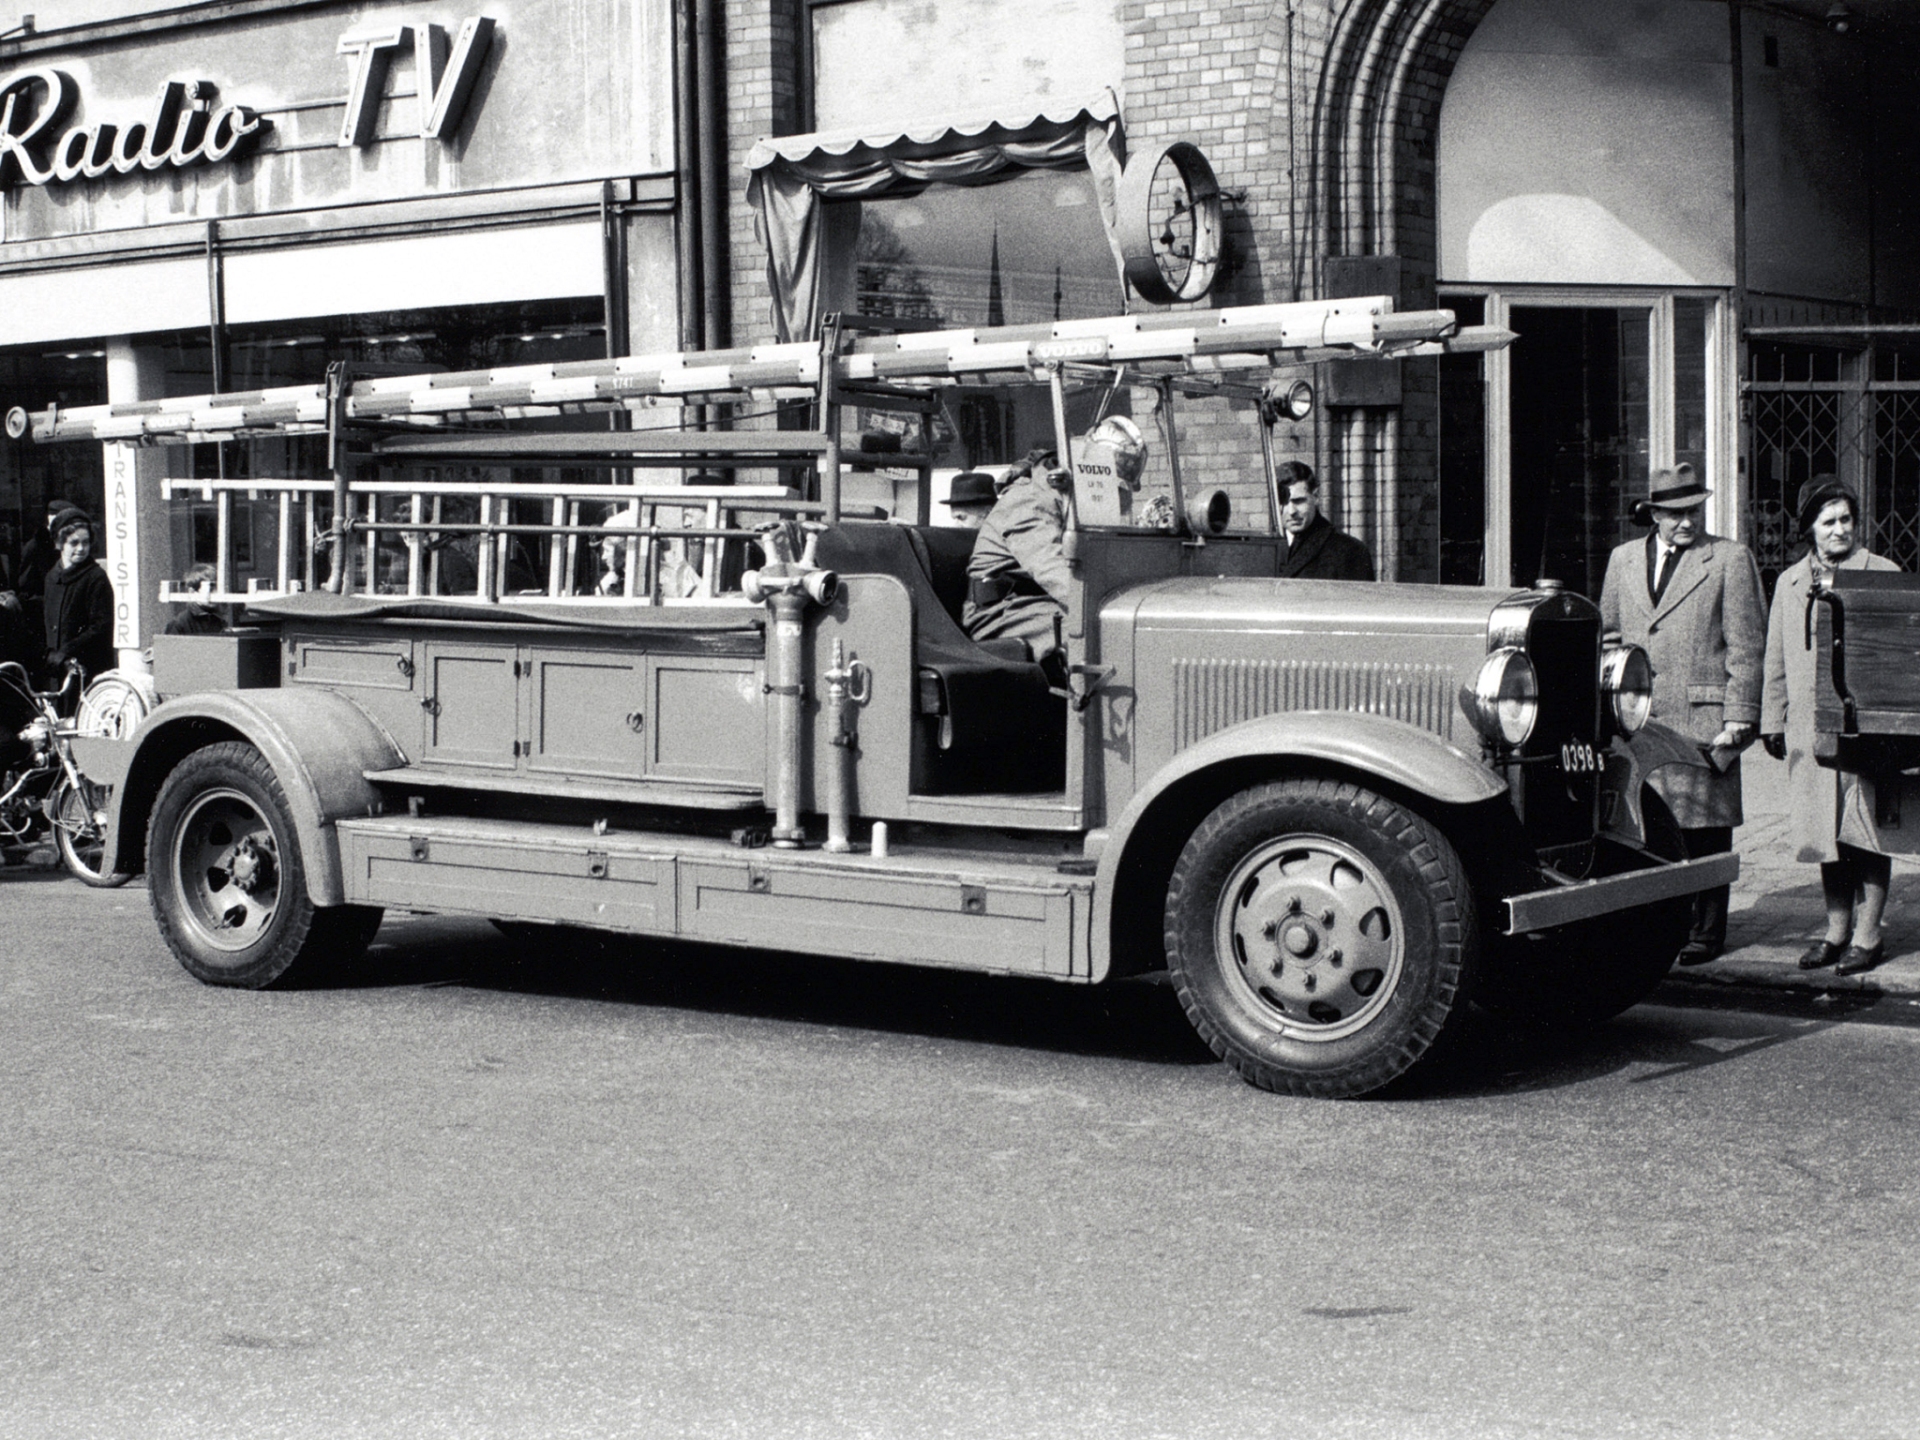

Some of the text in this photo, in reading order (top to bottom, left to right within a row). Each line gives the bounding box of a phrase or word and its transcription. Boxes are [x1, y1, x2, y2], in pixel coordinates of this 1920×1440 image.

[0, 16, 486, 185] Radio TV
[1038, 341, 1103, 358] VOLVO
[1077, 464, 1111, 476] VOLVO
[1562, 744, 1594, 771] 0398
